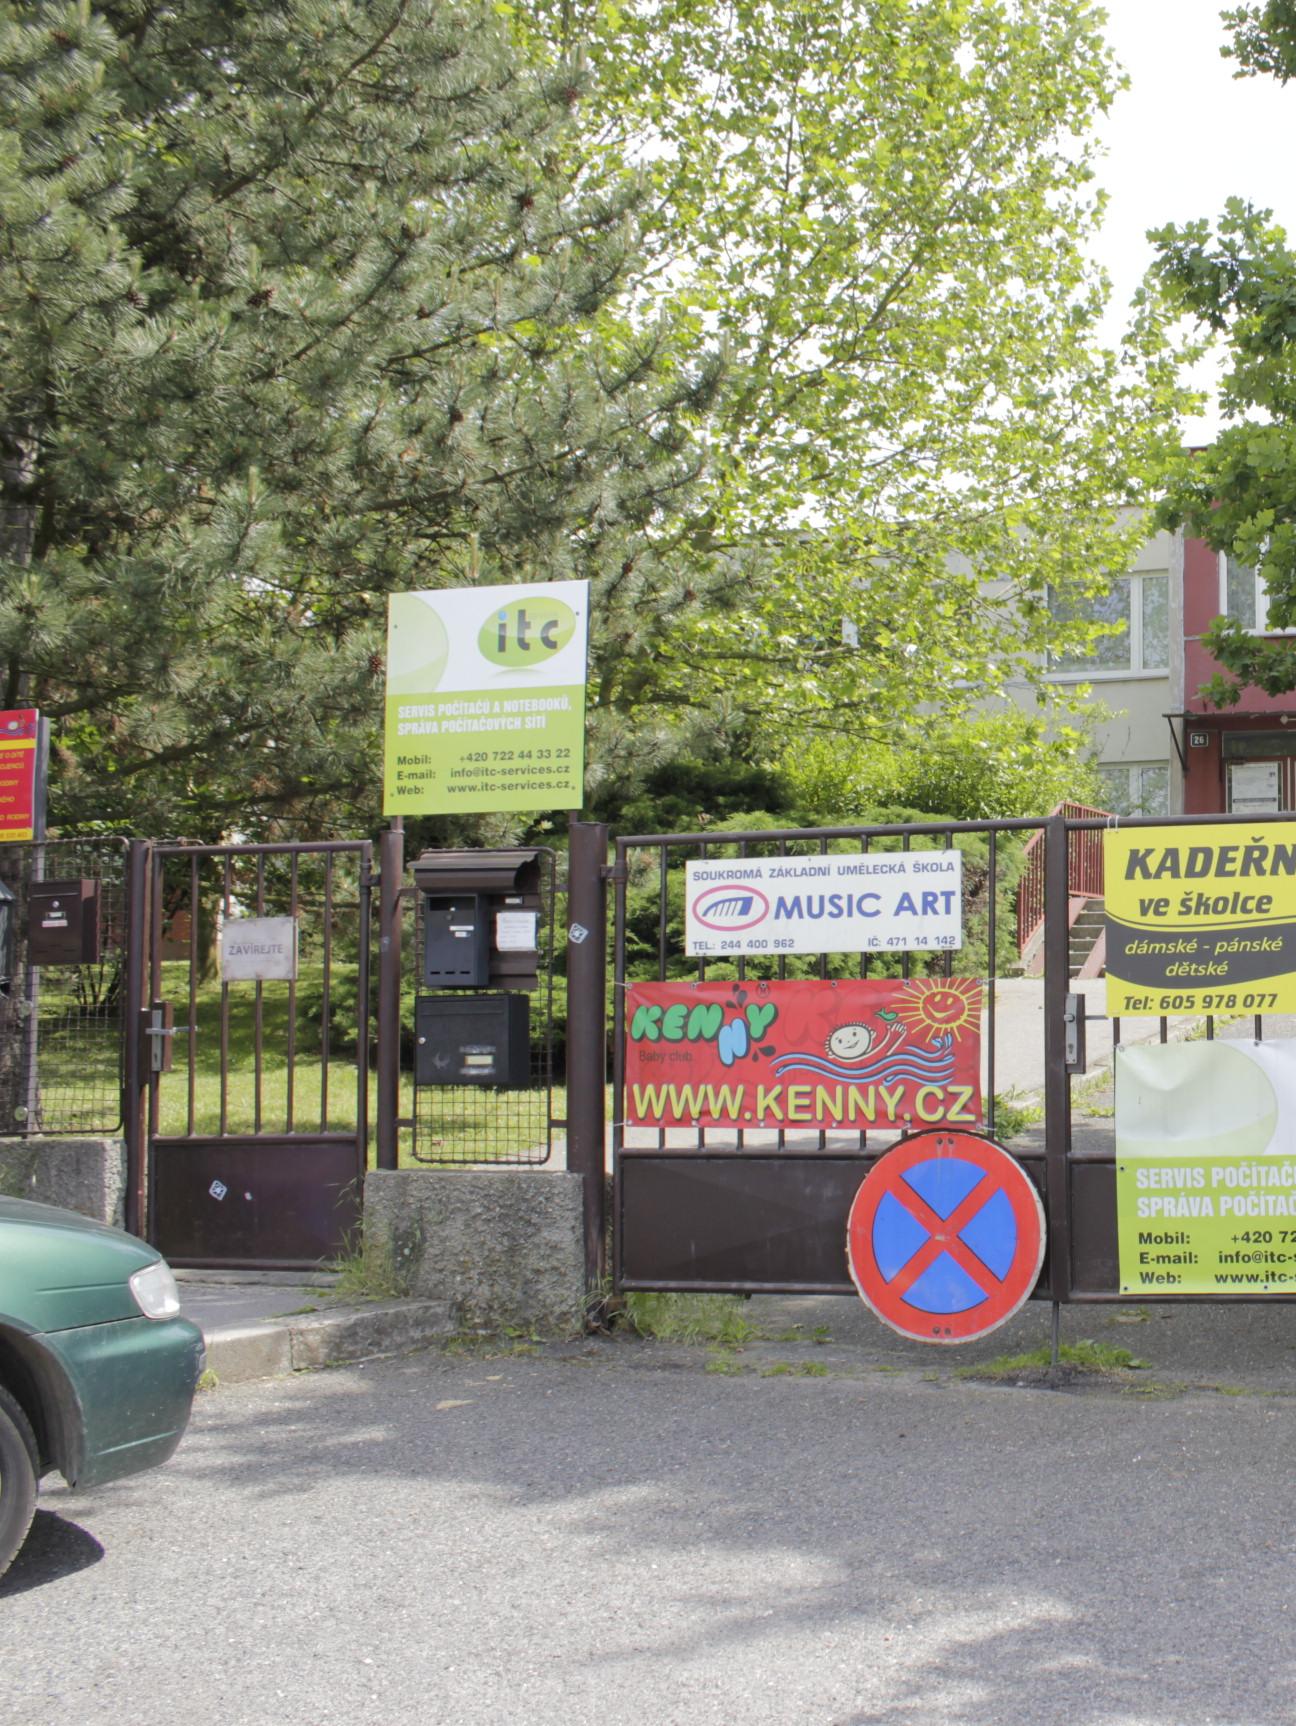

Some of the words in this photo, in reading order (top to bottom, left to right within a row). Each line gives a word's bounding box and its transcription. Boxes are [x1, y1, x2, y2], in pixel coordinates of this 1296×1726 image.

[497, 609, 559, 653] itc
[398, 703, 435, 719] SERVIS
[493, 702, 500, 714] A
[397, 719, 439, 737] SPRÁVA
[441, 715, 522, 734] POČÍTAČOVÝCH
[525, 714, 546, 729] SÍTÍ
[397, 754, 432, 766] Mobil:
[459, 752, 489, 763] +420
[493, 750, 514, 761] 722
[517, 749, 533, 760] 44
[536, 749, 551, 760] 33
[556, 748, 571, 759] 22
[397, 769, 437, 781] E-mail:
[450, 764, 571, 779] info@itc-services.cz
[397, 785, 425, 796] Web:
[447, 780, 571, 794] www.itc-services.cz
[693, 865, 762, 881] SOUKROMÁ
[769, 864, 831, 879] ZÁKLADNÍ
[838, 861, 906, 876] UMĚLECKÁ
[913, 860, 955, 873] ŠKOLA
[774, 892, 882, 921] MUSIC
[893, 890, 956, 917] ART
[1138, 896, 1170, 917] ve
[1178, 890, 1273, 917] školce
[228, 943, 284, 956] ZAVÍREJTE
[693, 940, 716, 951] TEL.:
[720, 940, 742, 951] 244
[746, 939, 768, 950] 400
[773, 938, 795, 949] 962
[868, 936, 881, 948] IČ:
[886, 937, 907, 947] 471
[914, 936, 928, 946] 14
[934, 935, 956, 946] 142
[1124, 938, 1198, 956] dámské
[1214, 936, 1283, 957] pánské
[1165, 960, 1229, 978] dětské
[1124, 995, 1154, 1011] Tel:
[1159, 995, 1196, 1010] 605
[1202, 994, 1237, 1009] 978
[1242, 993, 1278, 1008] 077
[639, 1050, 665, 1065] Baby
[632, 1083, 977, 1124] WWW.KENNY.CZ
[1136, 1167, 1205, 1189] SERVIS
[1137, 1192, 1214, 1217] SPRÁVA
[1138, 1231, 1191, 1246] Mobil:
[1231, 1230, 1273, 1244] +420
[1139, 1251, 1199, 1265] E-mail:
[1139, 1270, 1182, 1285] Web:
